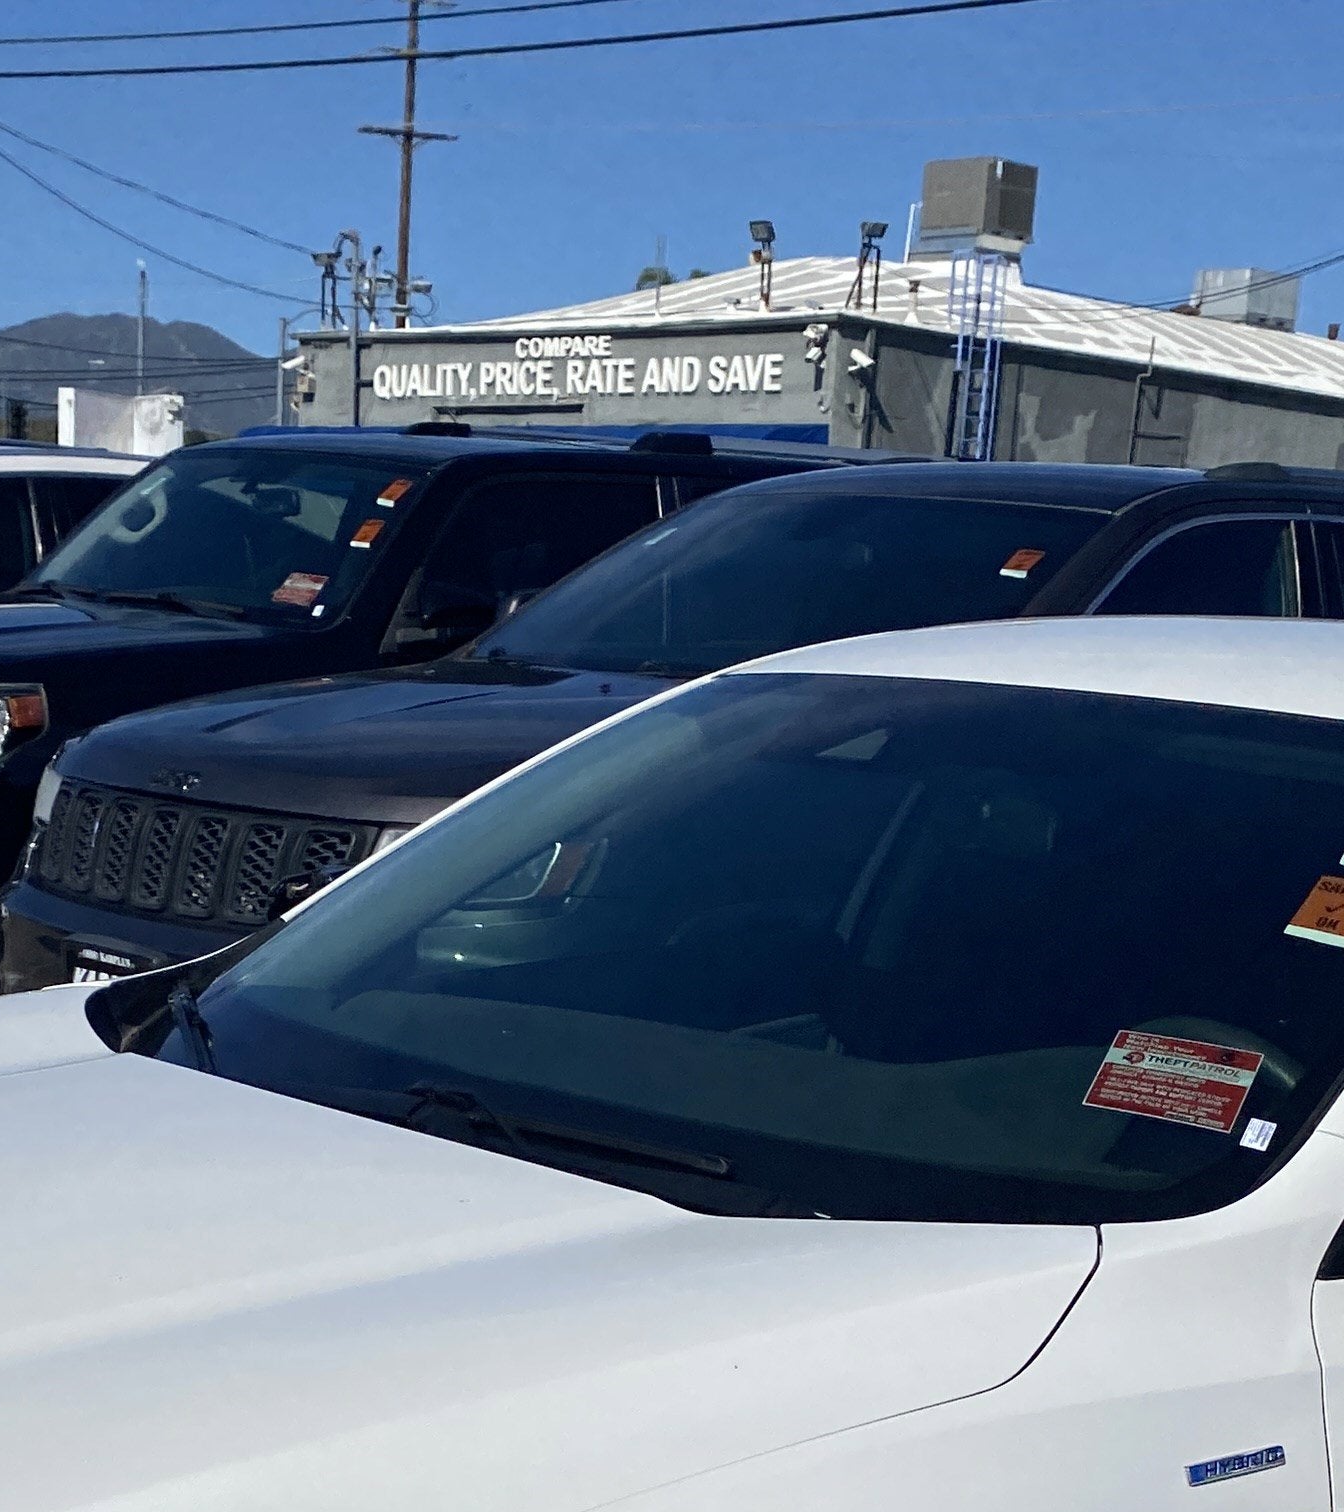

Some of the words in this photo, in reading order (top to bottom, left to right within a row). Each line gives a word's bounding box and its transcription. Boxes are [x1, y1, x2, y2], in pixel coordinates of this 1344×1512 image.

[515, 336, 612, 358] COMPARE
[373, 362, 477, 401] QUALITY,
[479, 360, 560, 401] PRICE,
[567, 358, 635, 395] RATE
[641, 356, 702, 394] AND
[707, 354, 785, 394] SAVE
